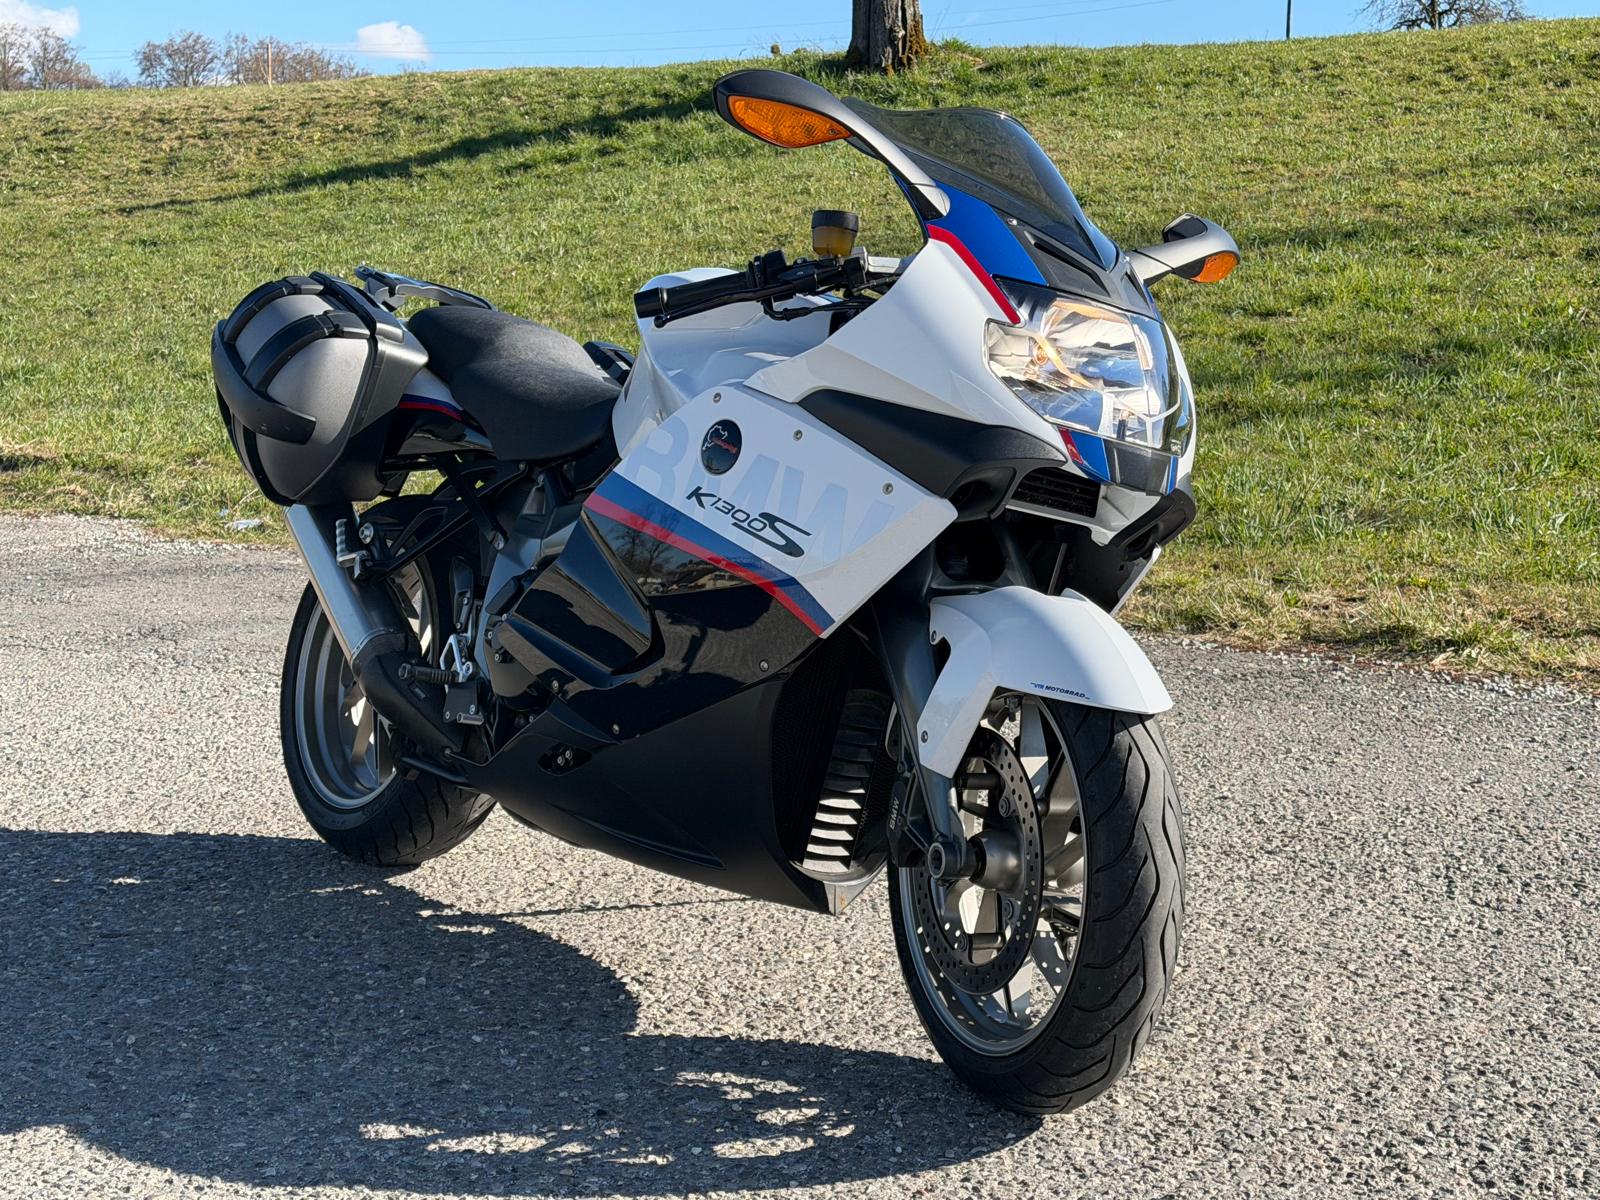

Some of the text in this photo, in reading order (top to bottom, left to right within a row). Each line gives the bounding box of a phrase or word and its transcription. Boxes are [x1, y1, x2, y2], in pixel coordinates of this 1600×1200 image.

[624, 415, 894, 572] BMW
[685, 485, 813, 558] K1300S
[1045, 685, 1086, 698] MOTORRAD
[890, 797, 900, 830] BMW
